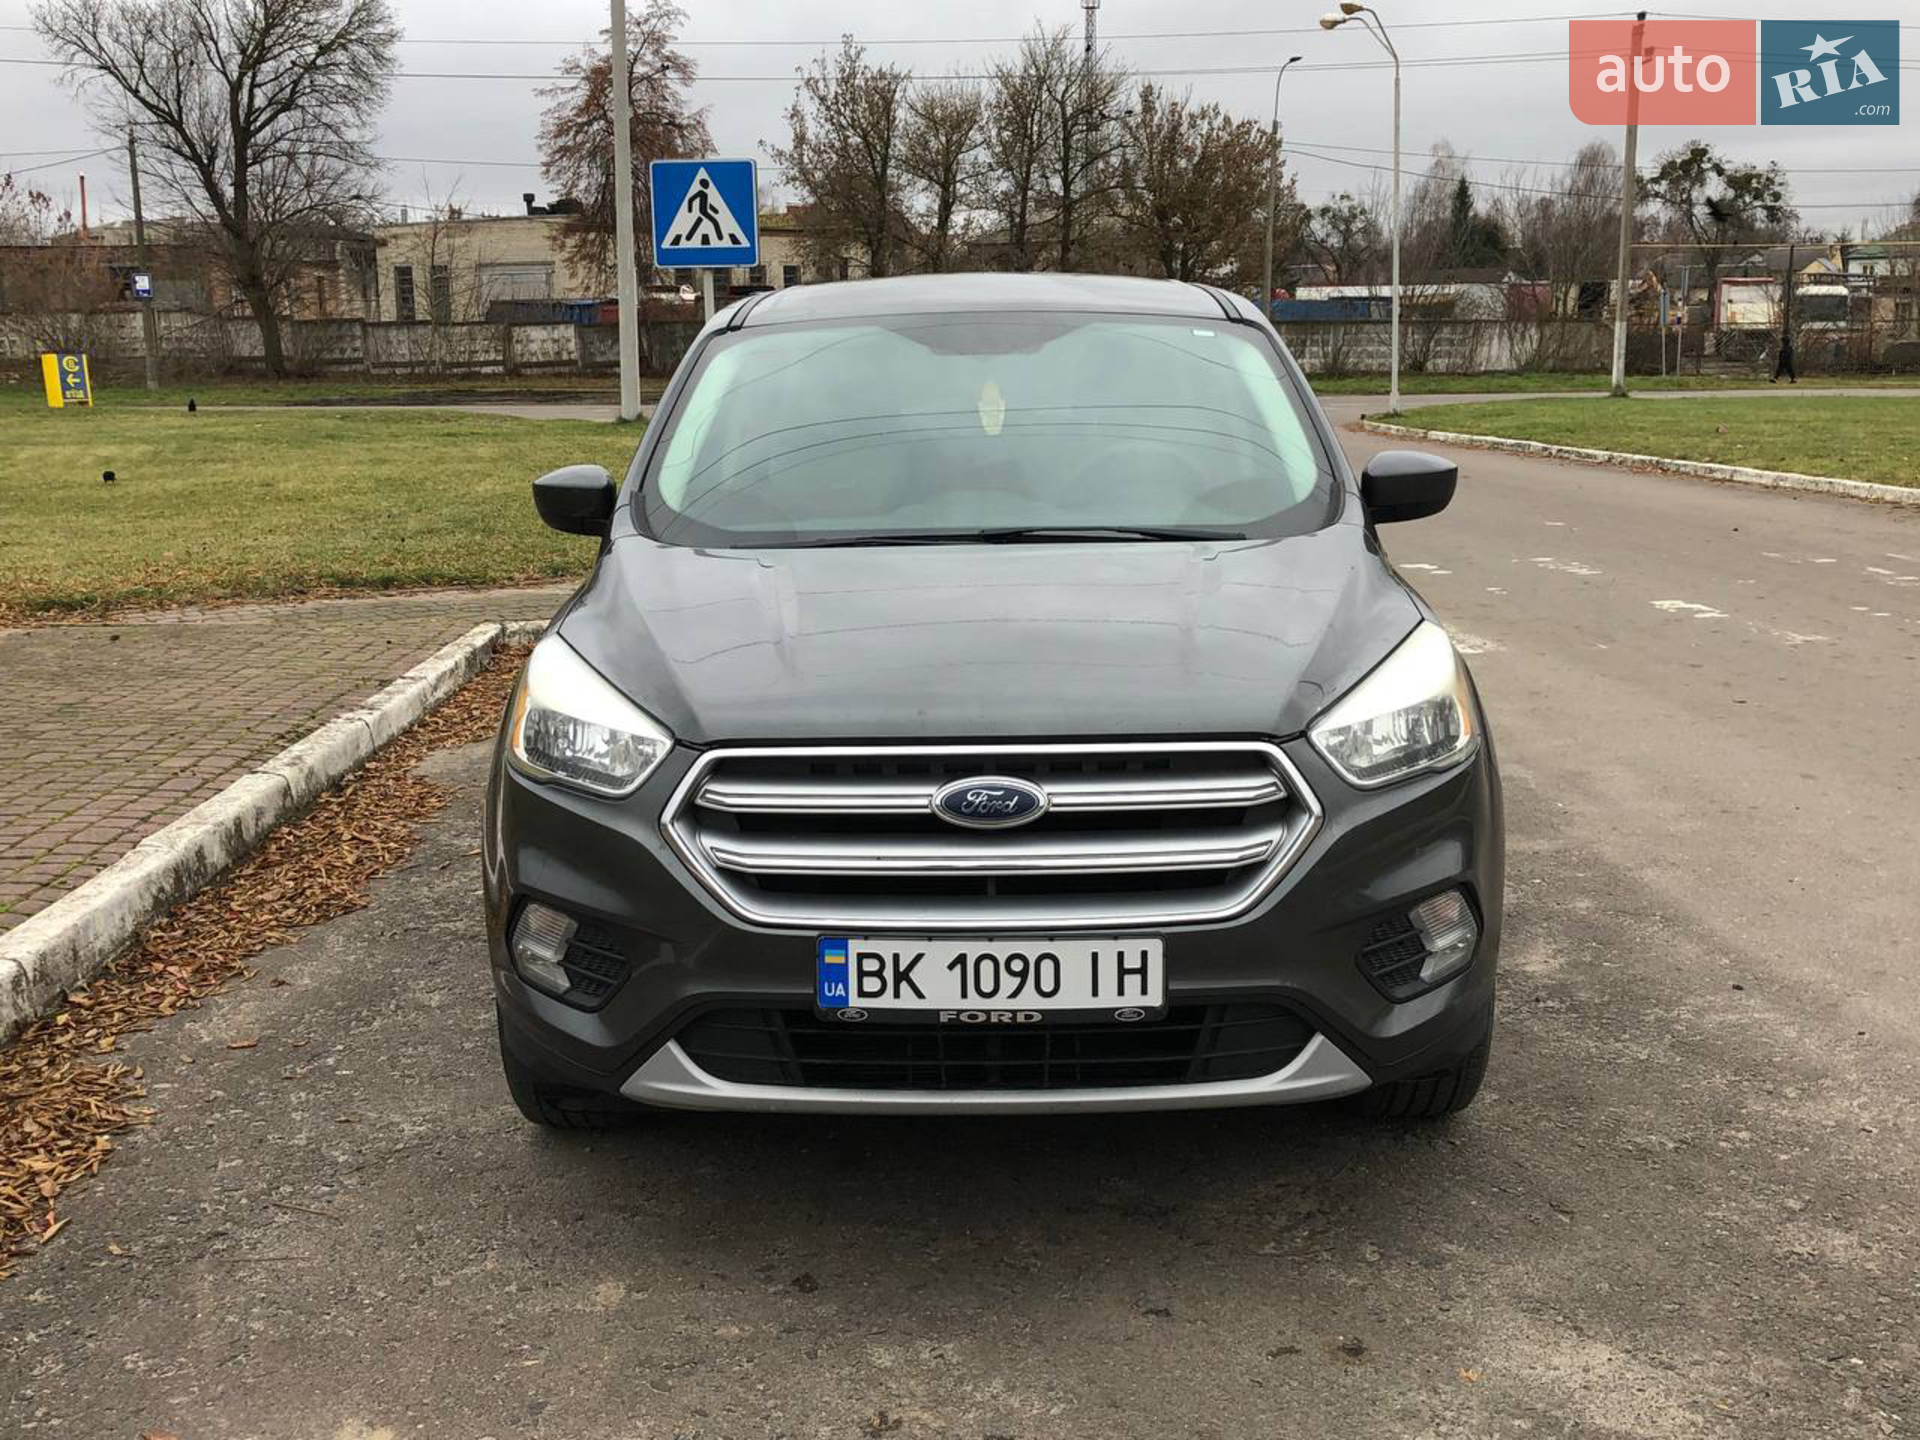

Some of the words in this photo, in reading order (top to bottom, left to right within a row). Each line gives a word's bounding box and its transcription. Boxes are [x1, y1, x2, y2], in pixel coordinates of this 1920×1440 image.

[961, 789, 1019, 814] Ford
[856, 952, 926, 999] BK
[946, 952, 1061, 999] 1090
[1090, 950, 1148, 997] IH
[824, 983, 846, 997] UA
[939, 1010, 1043, 1023] FORD
